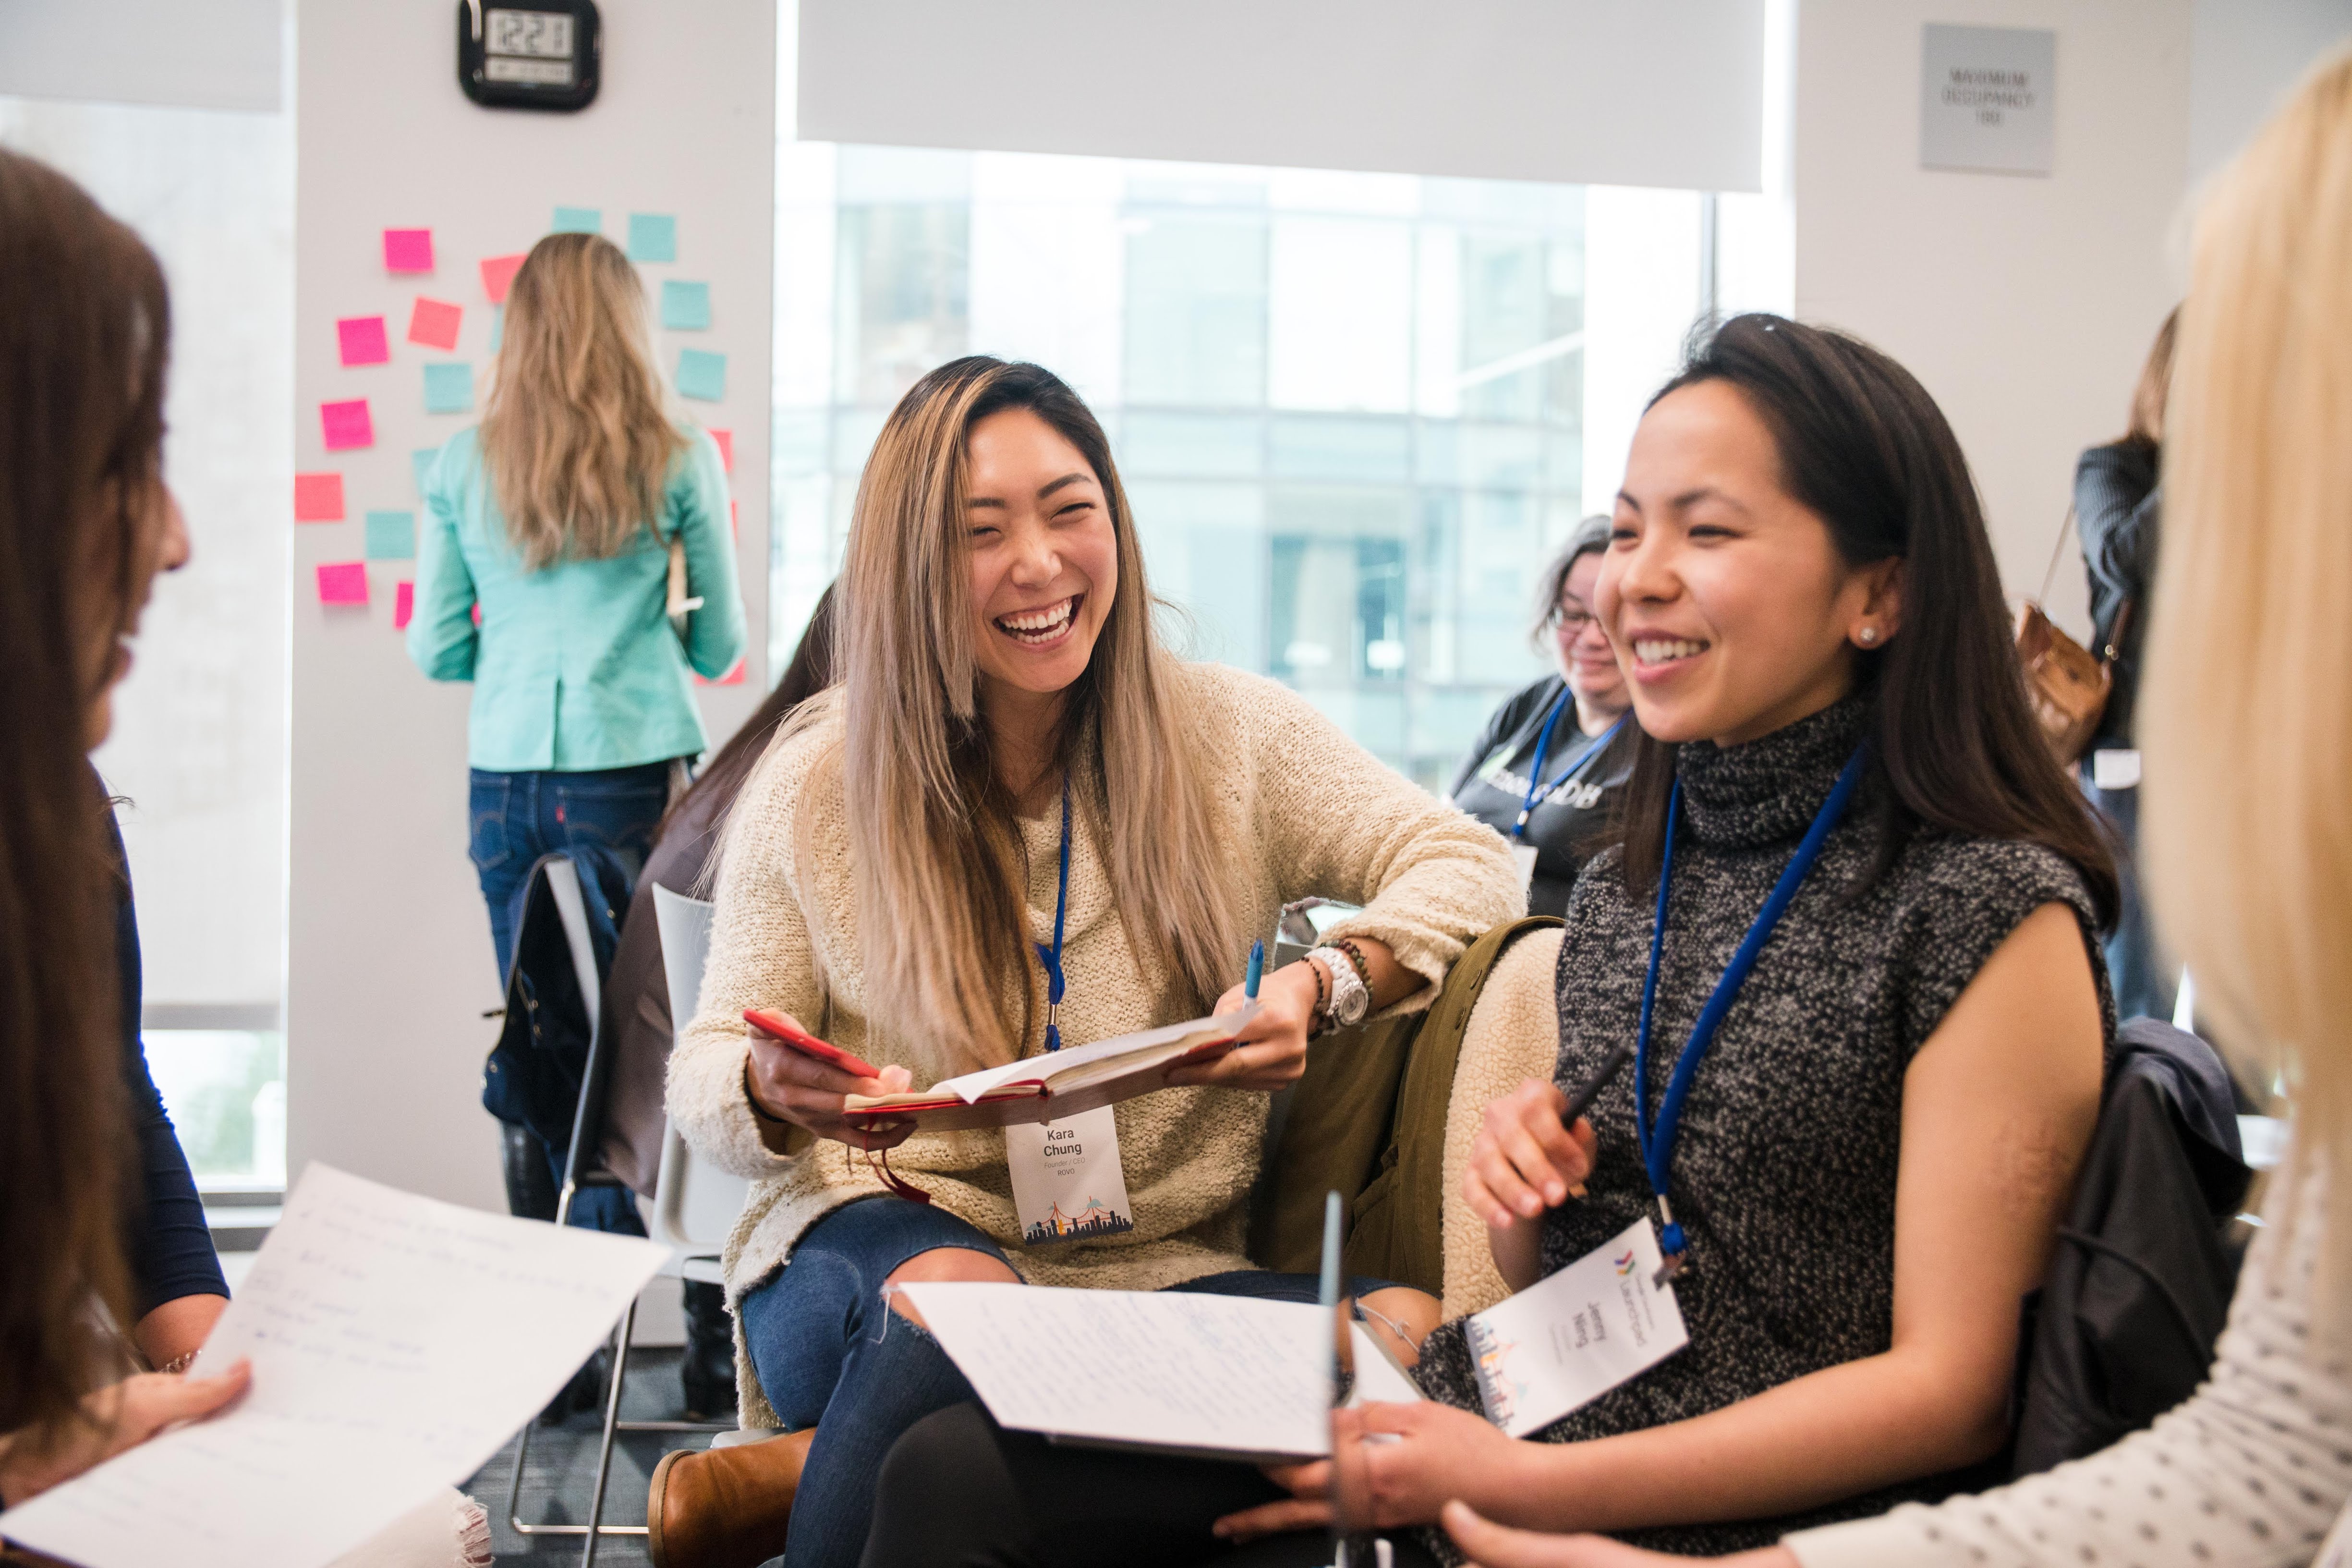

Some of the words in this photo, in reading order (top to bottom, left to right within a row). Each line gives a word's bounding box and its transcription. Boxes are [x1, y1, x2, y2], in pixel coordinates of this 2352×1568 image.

[1950, 69, 2028, 85] MAXIMUM
[1943, 88, 2034, 107] OCCUPANCY
[1047, 1130, 1074, 1141] Kara
[1044, 1143, 1082, 1156] Chung
[1044, 1160, 1067, 1168] Founder
[1057, 1168, 1075, 1176] ROVO
